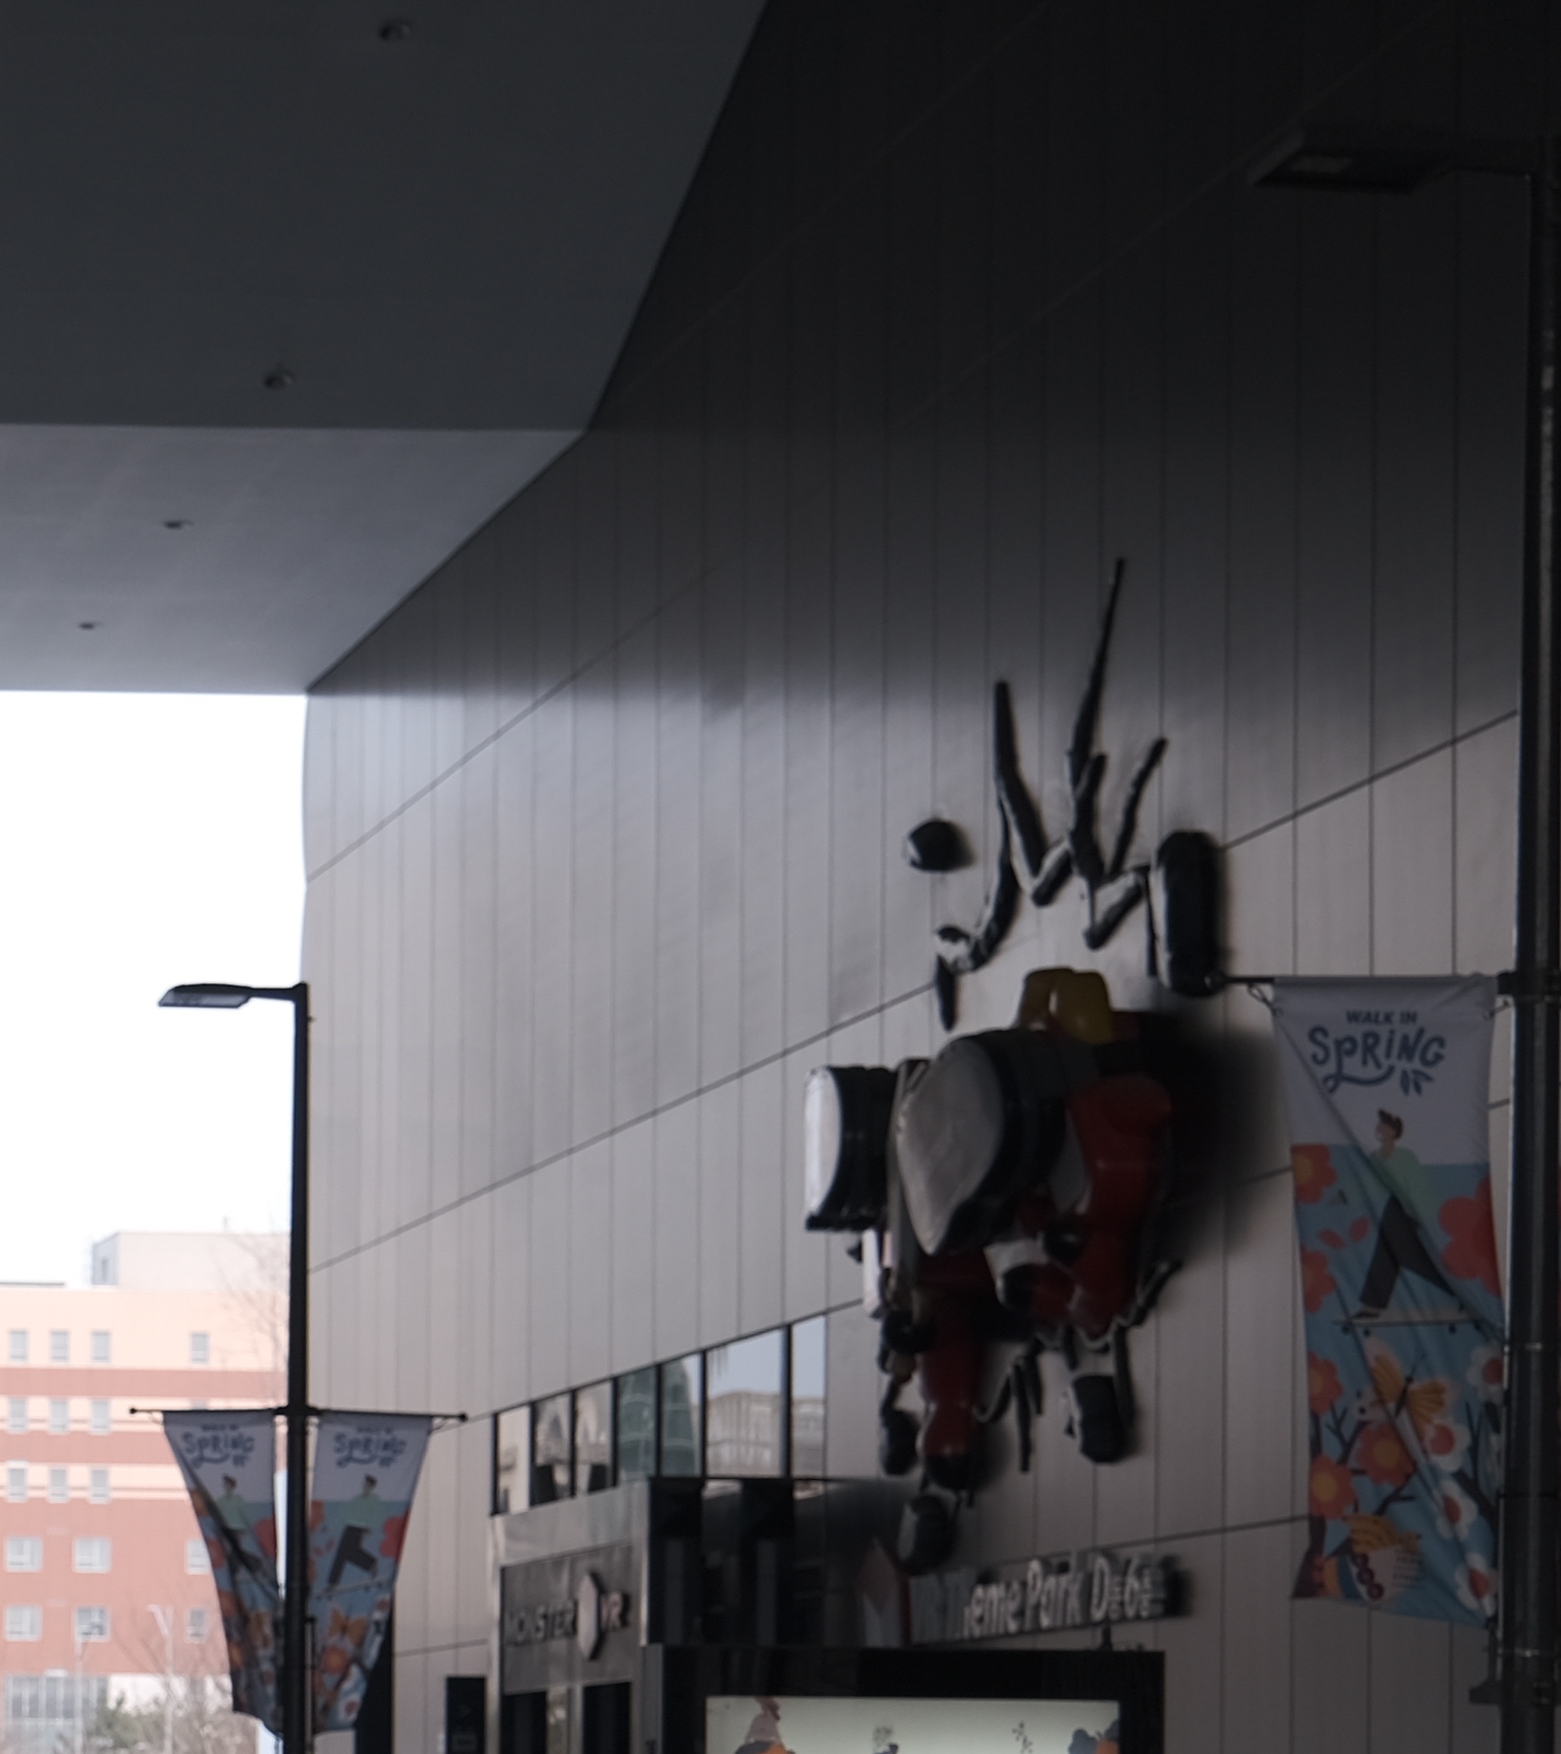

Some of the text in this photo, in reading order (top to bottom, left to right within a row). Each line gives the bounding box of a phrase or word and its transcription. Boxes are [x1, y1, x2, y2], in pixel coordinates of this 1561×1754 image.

[1346, 1010, 1418, 1024] WALK IN
[1024, 1551, 1084, 1631] Park
